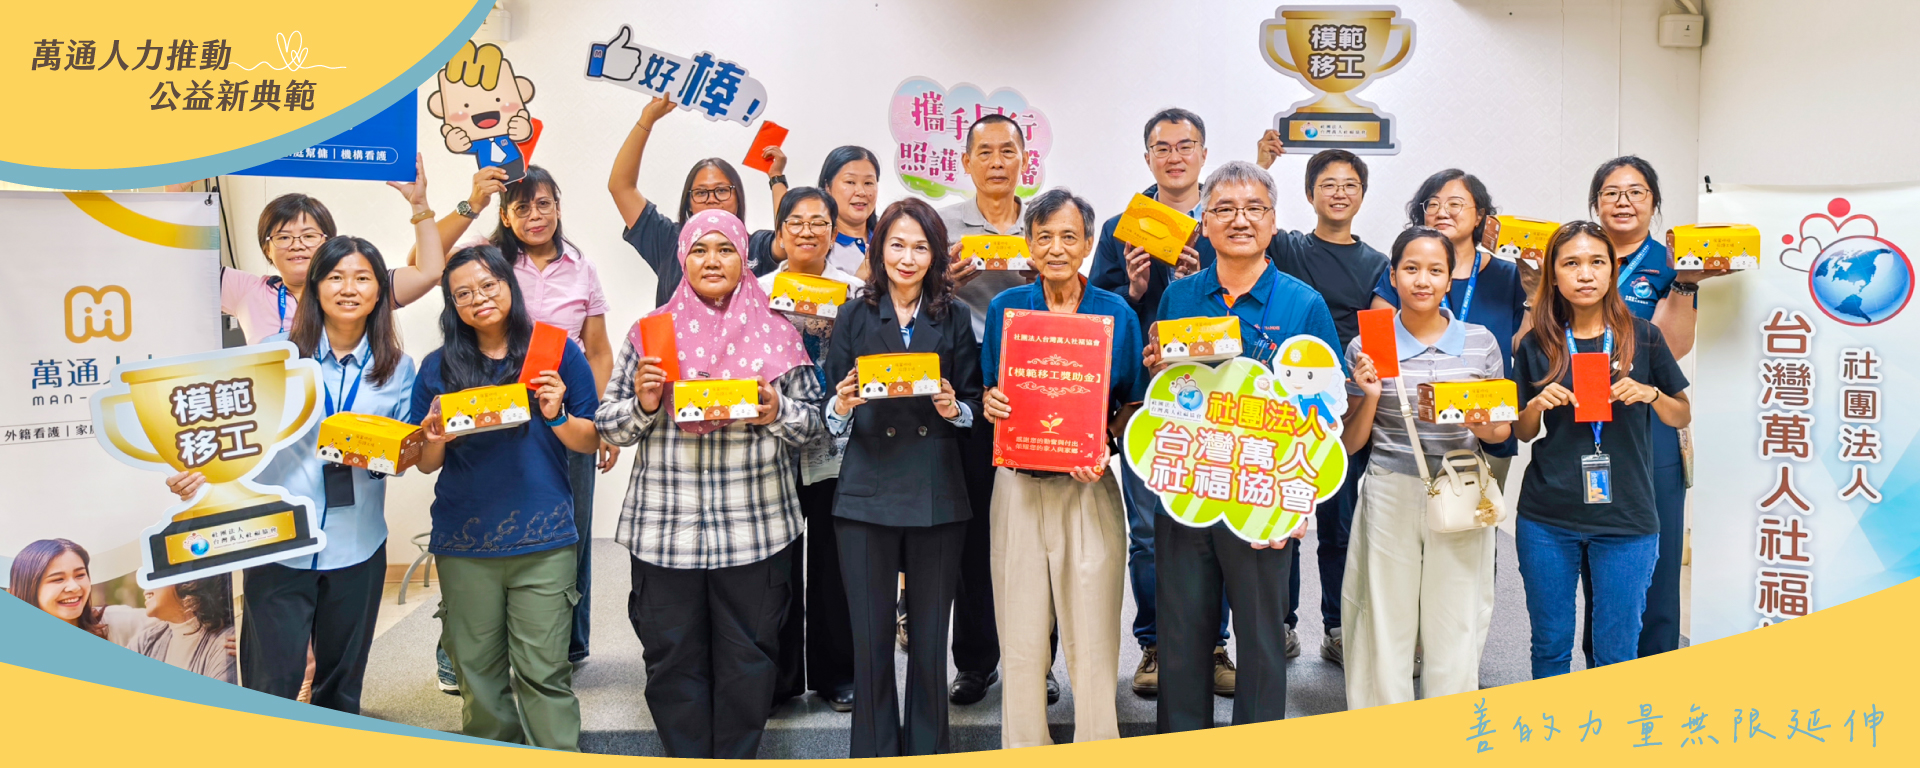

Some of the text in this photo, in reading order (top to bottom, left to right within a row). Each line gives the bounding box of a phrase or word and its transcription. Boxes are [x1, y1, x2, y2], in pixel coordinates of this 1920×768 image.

[1308, 25, 1366, 50] 模範
[638, 52, 760, 122] 好棒!
[1308, 54, 1365, 78] 移工
[341, 149, 387, 162] 機構看護
[1014, 333, 1100, 347] 社團法人台灣萬人社福協會
[171, 379, 256, 425] 模範
[1207, 392, 1325, 440] 社團法人
[1842, 350, 1879, 500] 社團法人
[4, 426, 60, 442] 外籍看護
[177, 422, 260, 468] 移工
[1154, 421, 1319, 479] 台灣萬人
[1150, 458, 1319, 514] 社福協會
[1760, 311, 1812, 628] 台灣萬人社福
